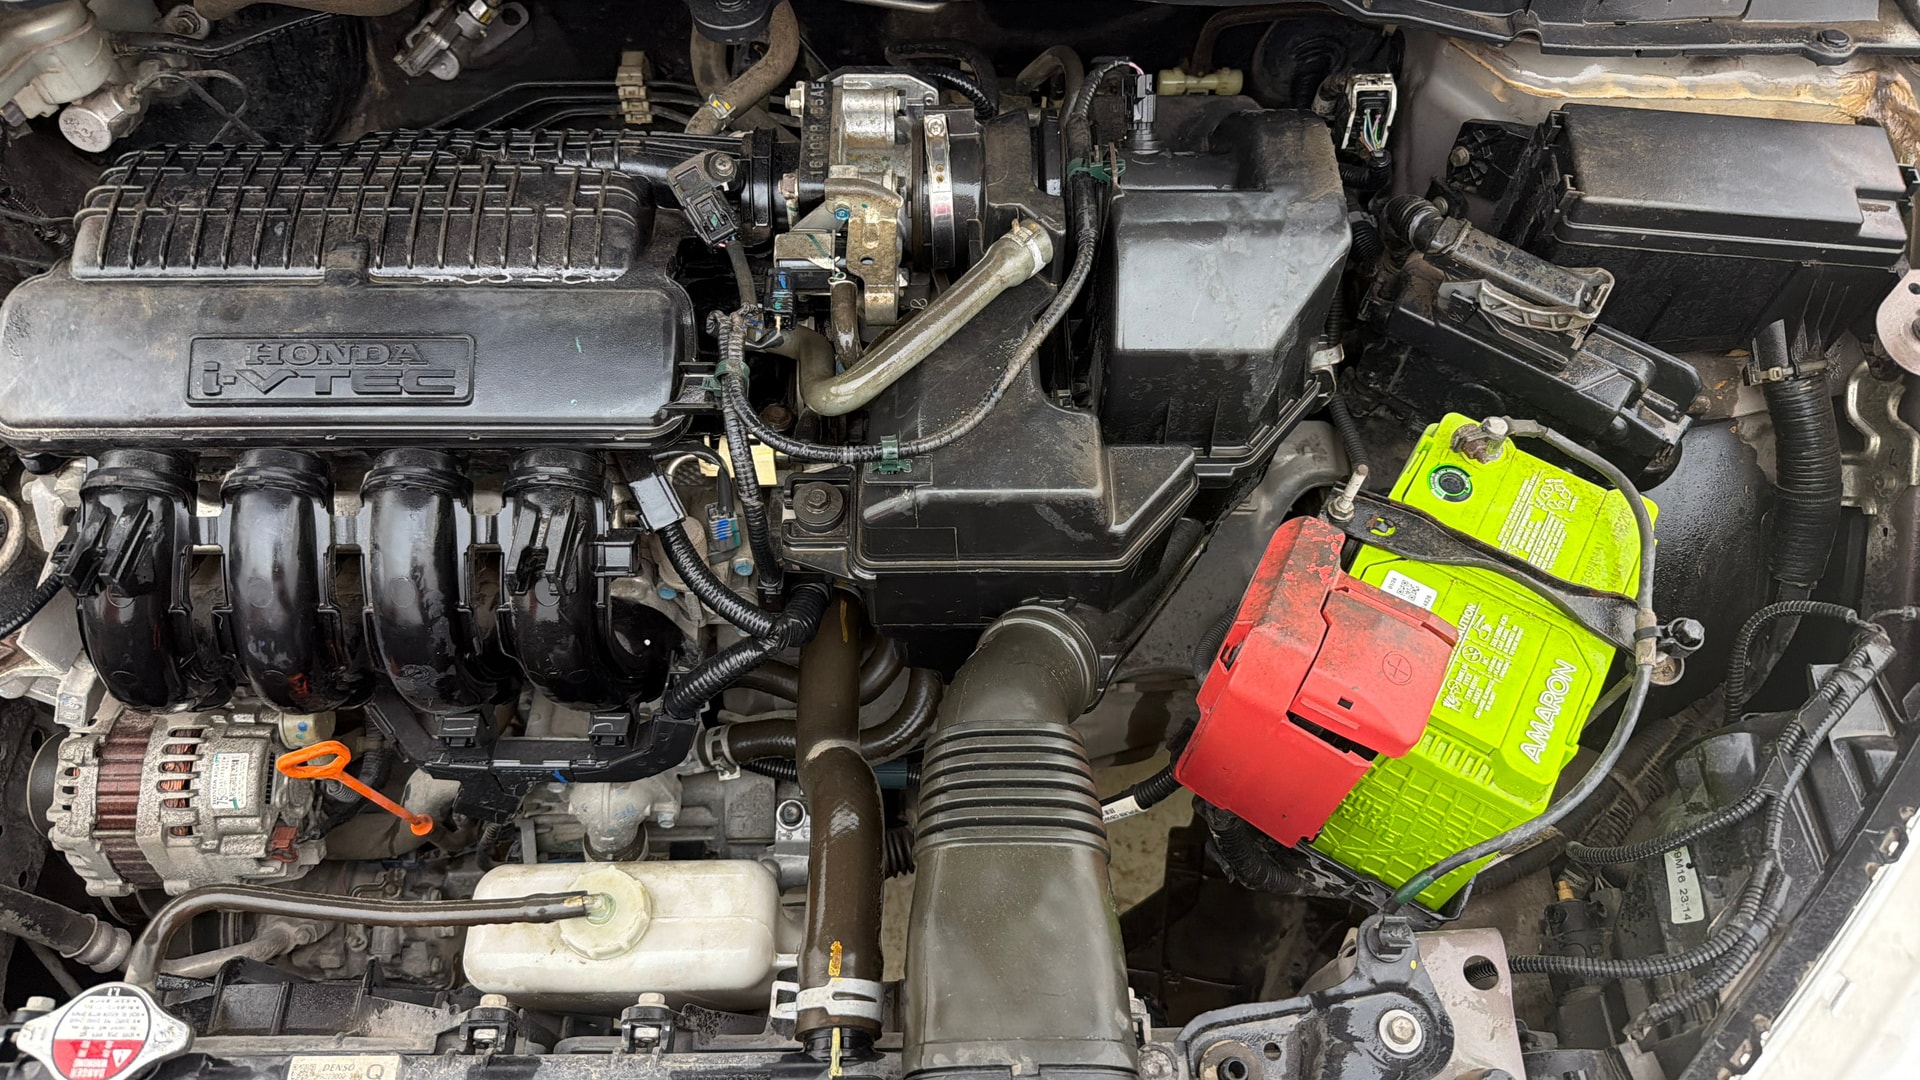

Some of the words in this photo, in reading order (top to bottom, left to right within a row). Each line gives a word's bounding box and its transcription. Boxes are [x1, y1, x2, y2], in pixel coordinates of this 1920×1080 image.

[246, 343, 427, 365] HONDA
[203, 361, 456, 395] i-VTEC
[1520, 659, 1577, 764] AMARON
[1680, 888, 1692, 920] 23:14
[323, 1064, 356, 1072] DENSO
[366, 1064, 385, 1080] Q
